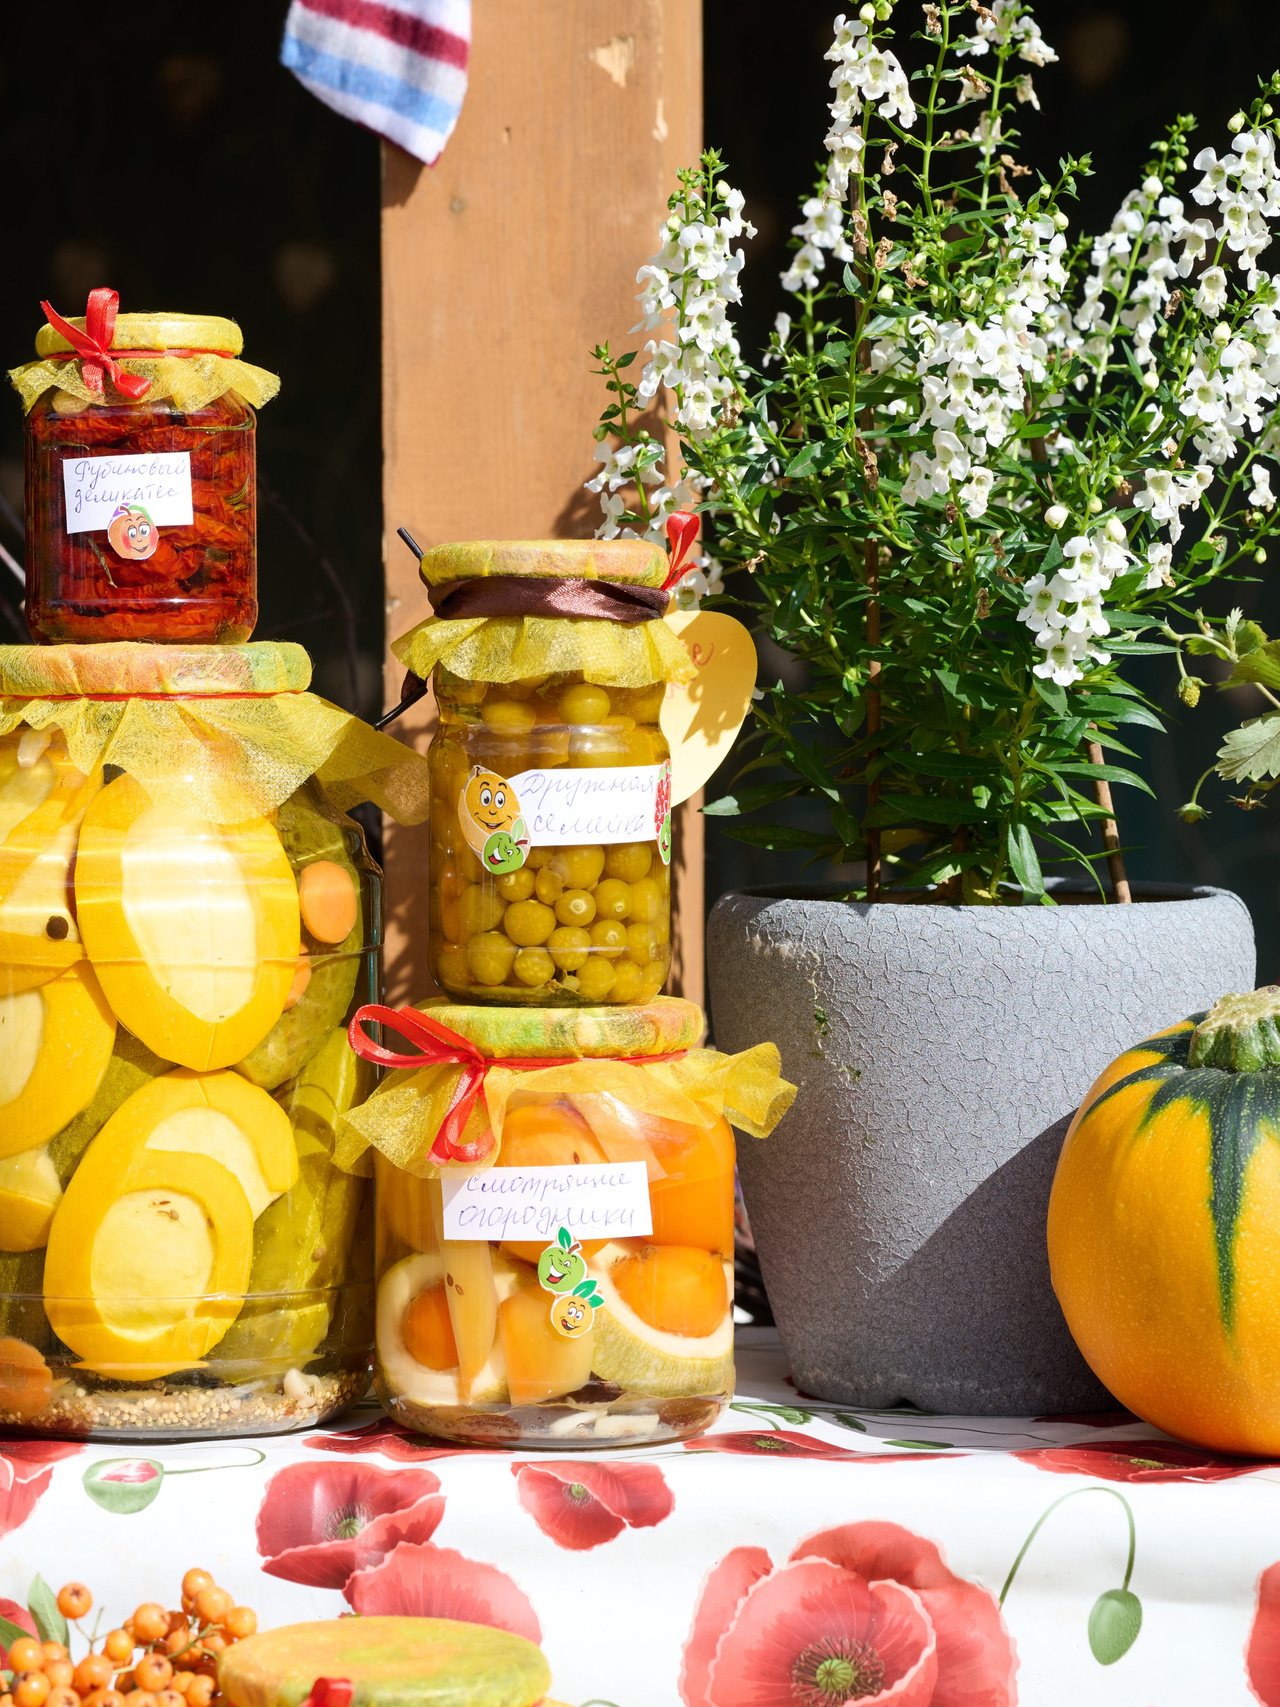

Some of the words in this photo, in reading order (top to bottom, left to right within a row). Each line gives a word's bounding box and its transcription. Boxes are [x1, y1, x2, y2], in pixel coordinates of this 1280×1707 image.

[74, 457, 187, 490] Рубиновый
[74, 484, 179, 514] деликатес
[519, 772, 656, 810] Дружная
[533, 813, 646, 836] семейка
